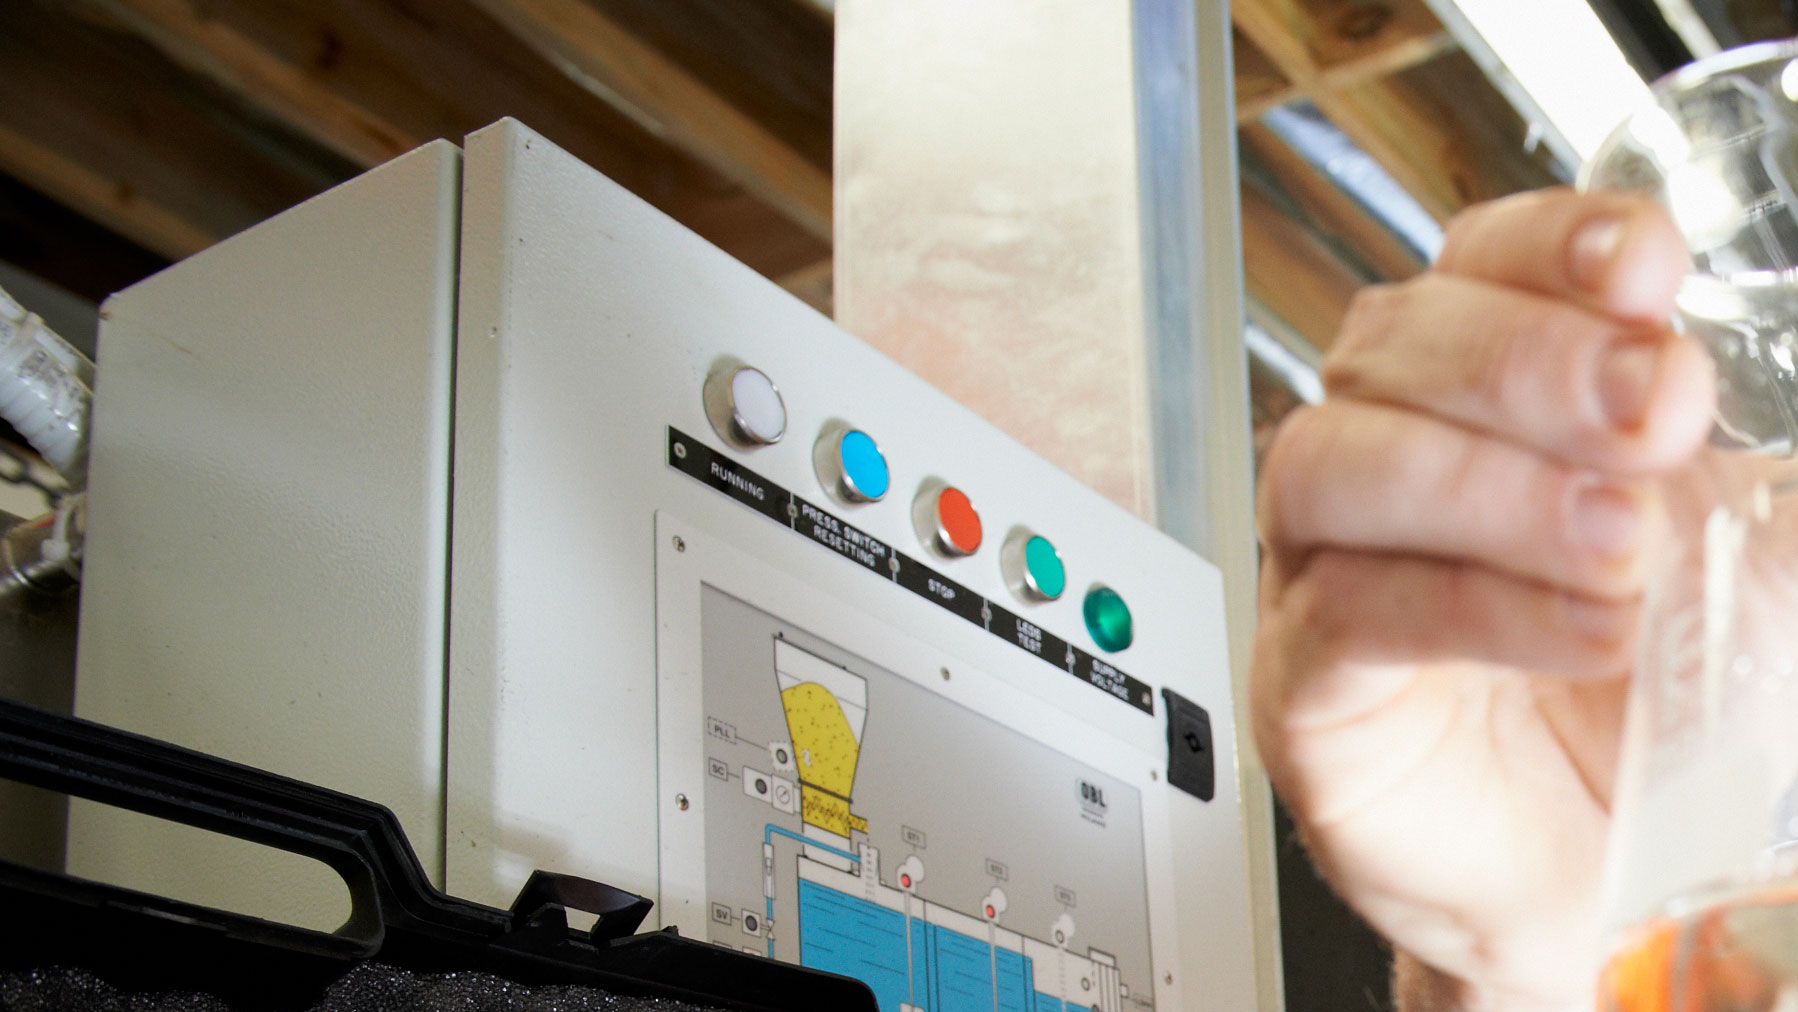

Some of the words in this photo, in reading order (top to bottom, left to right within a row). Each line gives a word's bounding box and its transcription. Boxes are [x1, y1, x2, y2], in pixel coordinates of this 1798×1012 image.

[711, 461, 765, 500] RUNNING
[802, 504, 841, 534] PRESS.
[844, 526, 885, 557] SWITCH
[813, 525, 876, 567] RESETTING
[928, 578, 956, 600] STOP
[1017, 632, 1042, 654] TEST
[1092, 659, 1126, 684] SUPPLY
[1089, 671, 1130, 701] VOLTAGE
[712, 764, 724, 776] SC
[716, 909, 728, 920] SV
